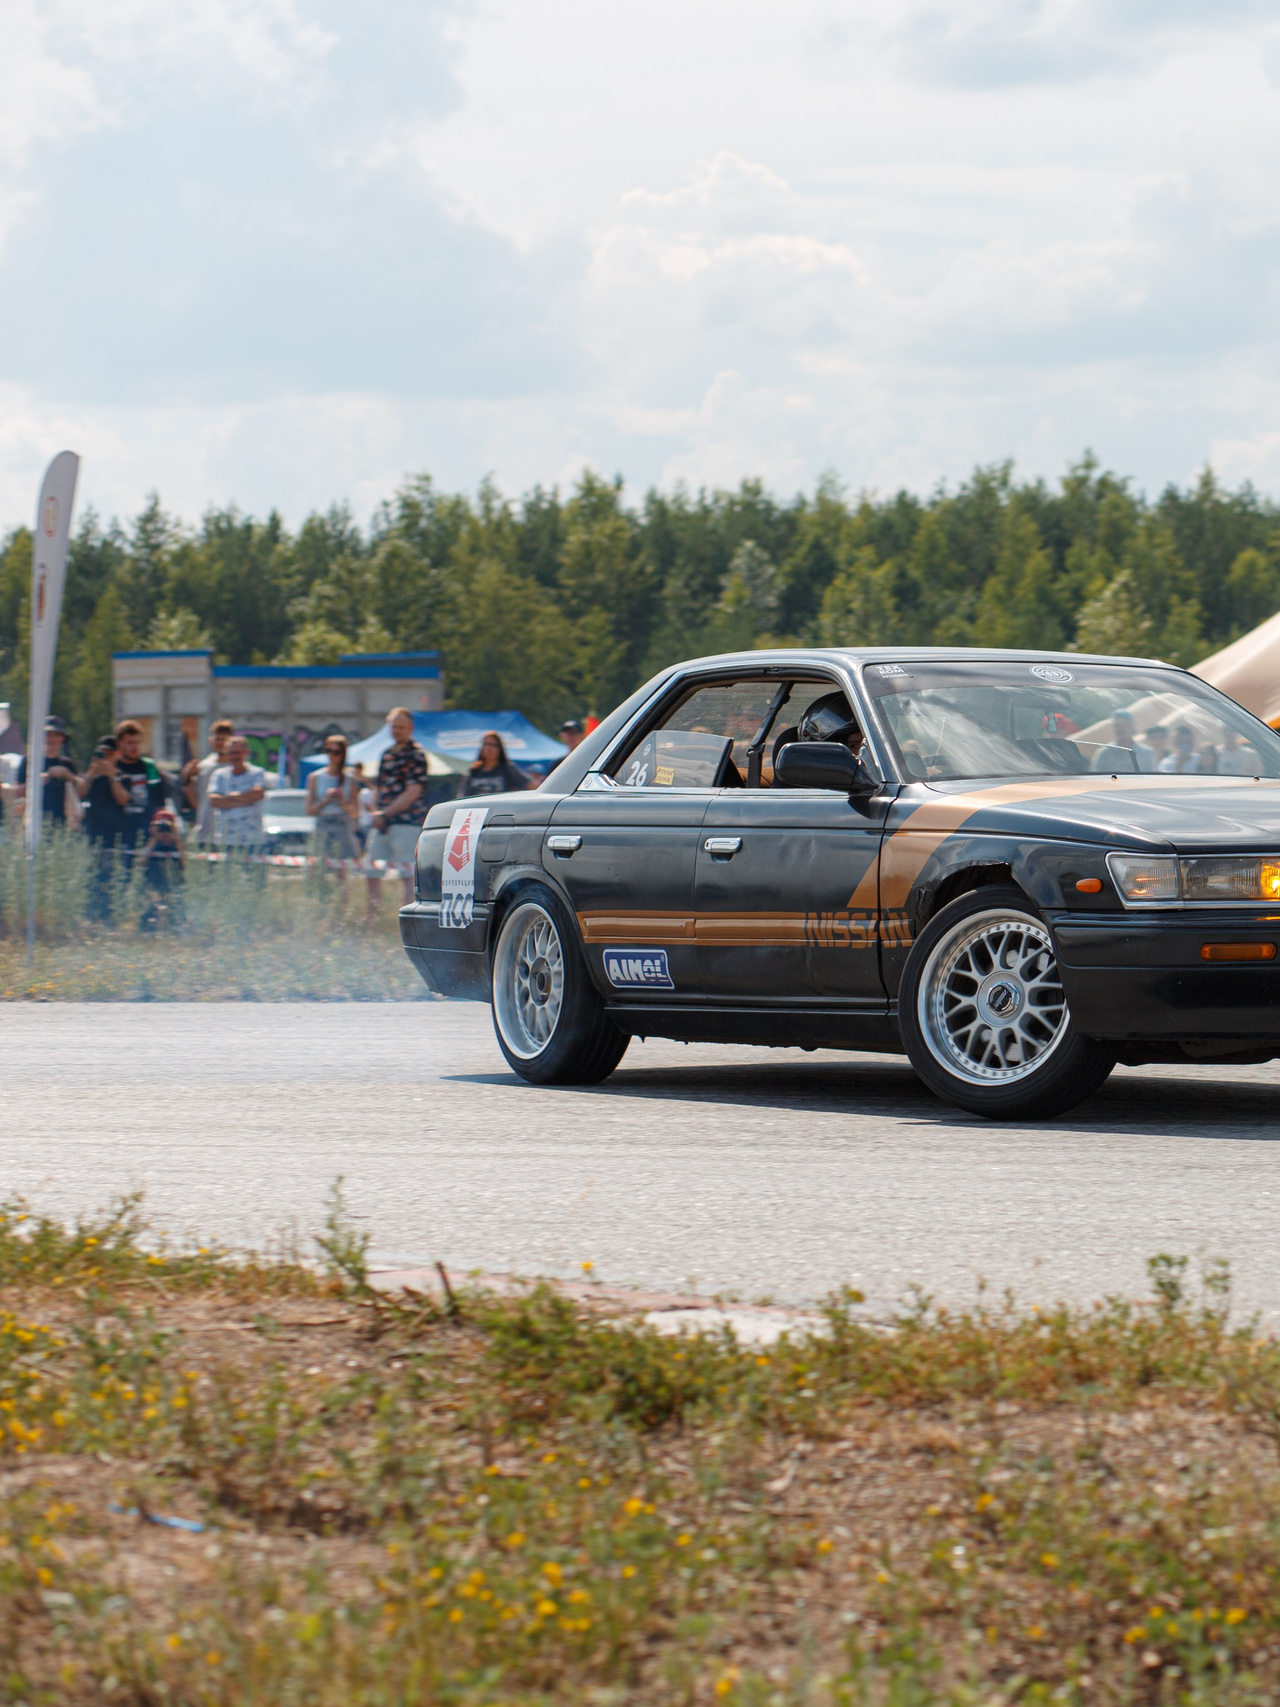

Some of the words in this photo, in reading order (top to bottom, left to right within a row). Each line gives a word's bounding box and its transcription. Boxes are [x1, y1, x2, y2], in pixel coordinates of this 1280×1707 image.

[626, 760, 649, 787] 26
[807, 911, 913, 949] NISSAN
[609, 958, 669, 982] AIMOL
